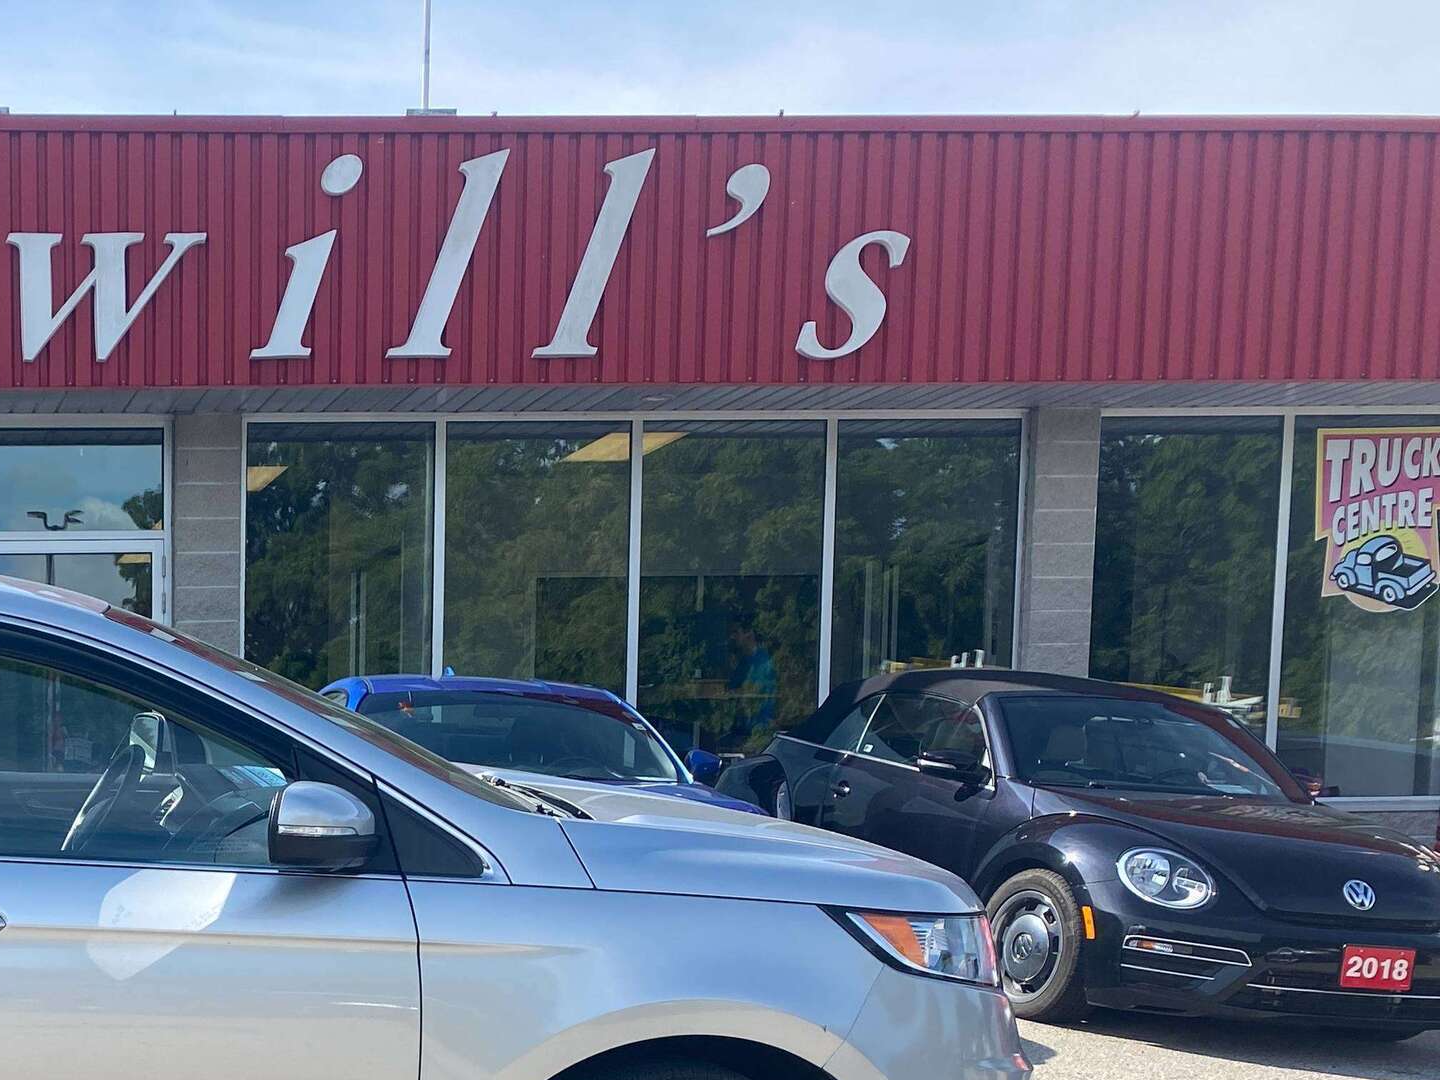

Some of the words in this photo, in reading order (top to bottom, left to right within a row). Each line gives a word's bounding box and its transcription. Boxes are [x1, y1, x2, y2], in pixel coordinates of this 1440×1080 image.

[1325, 437, 1440, 503] TRUCK
[1332, 487, 1434, 547] CENTRE
[1346, 956, 1409, 981] 2018
